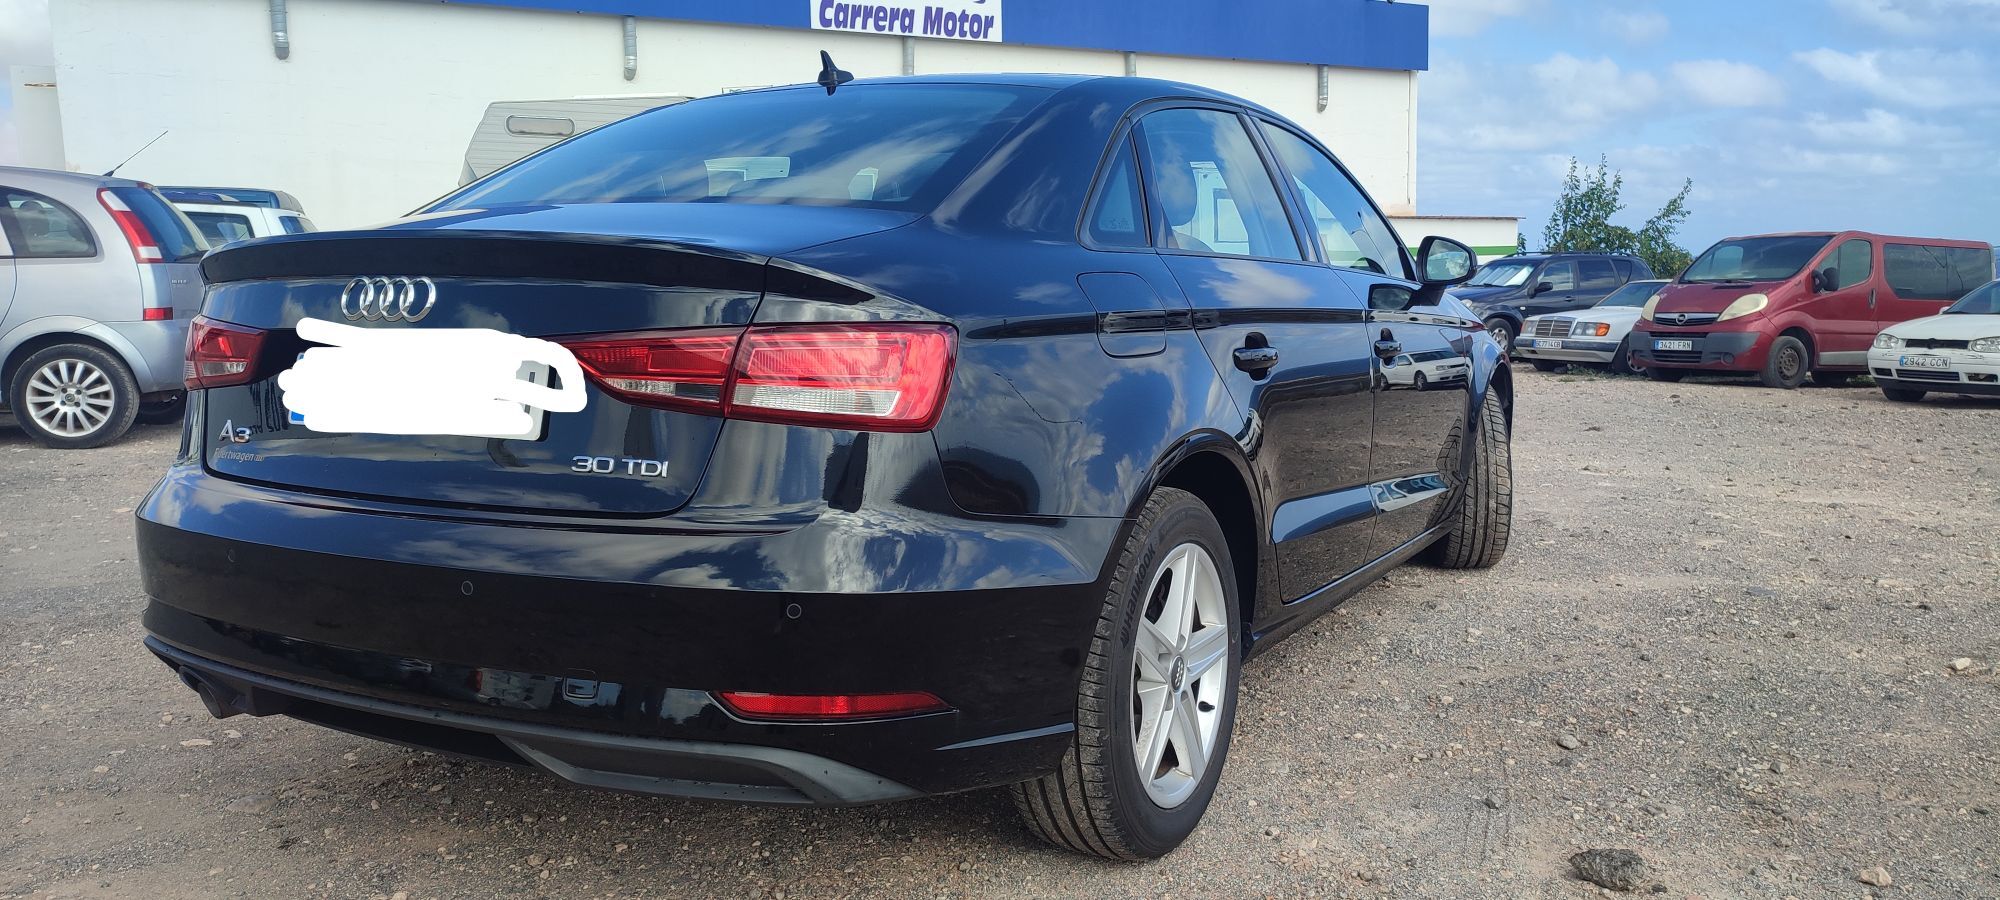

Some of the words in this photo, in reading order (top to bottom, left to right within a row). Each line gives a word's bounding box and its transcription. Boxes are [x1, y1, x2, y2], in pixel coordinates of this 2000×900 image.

[819, 0, 915, 33] Carrera
[922, 6, 994, 39] Motor
[1904, 357, 1927, 367] 2942
[1930, 359, 1948, 367] CCN
[218, 419, 251, 443] A3
[571, 455, 615, 474] 30
[621, 458, 669, 478] TDI
